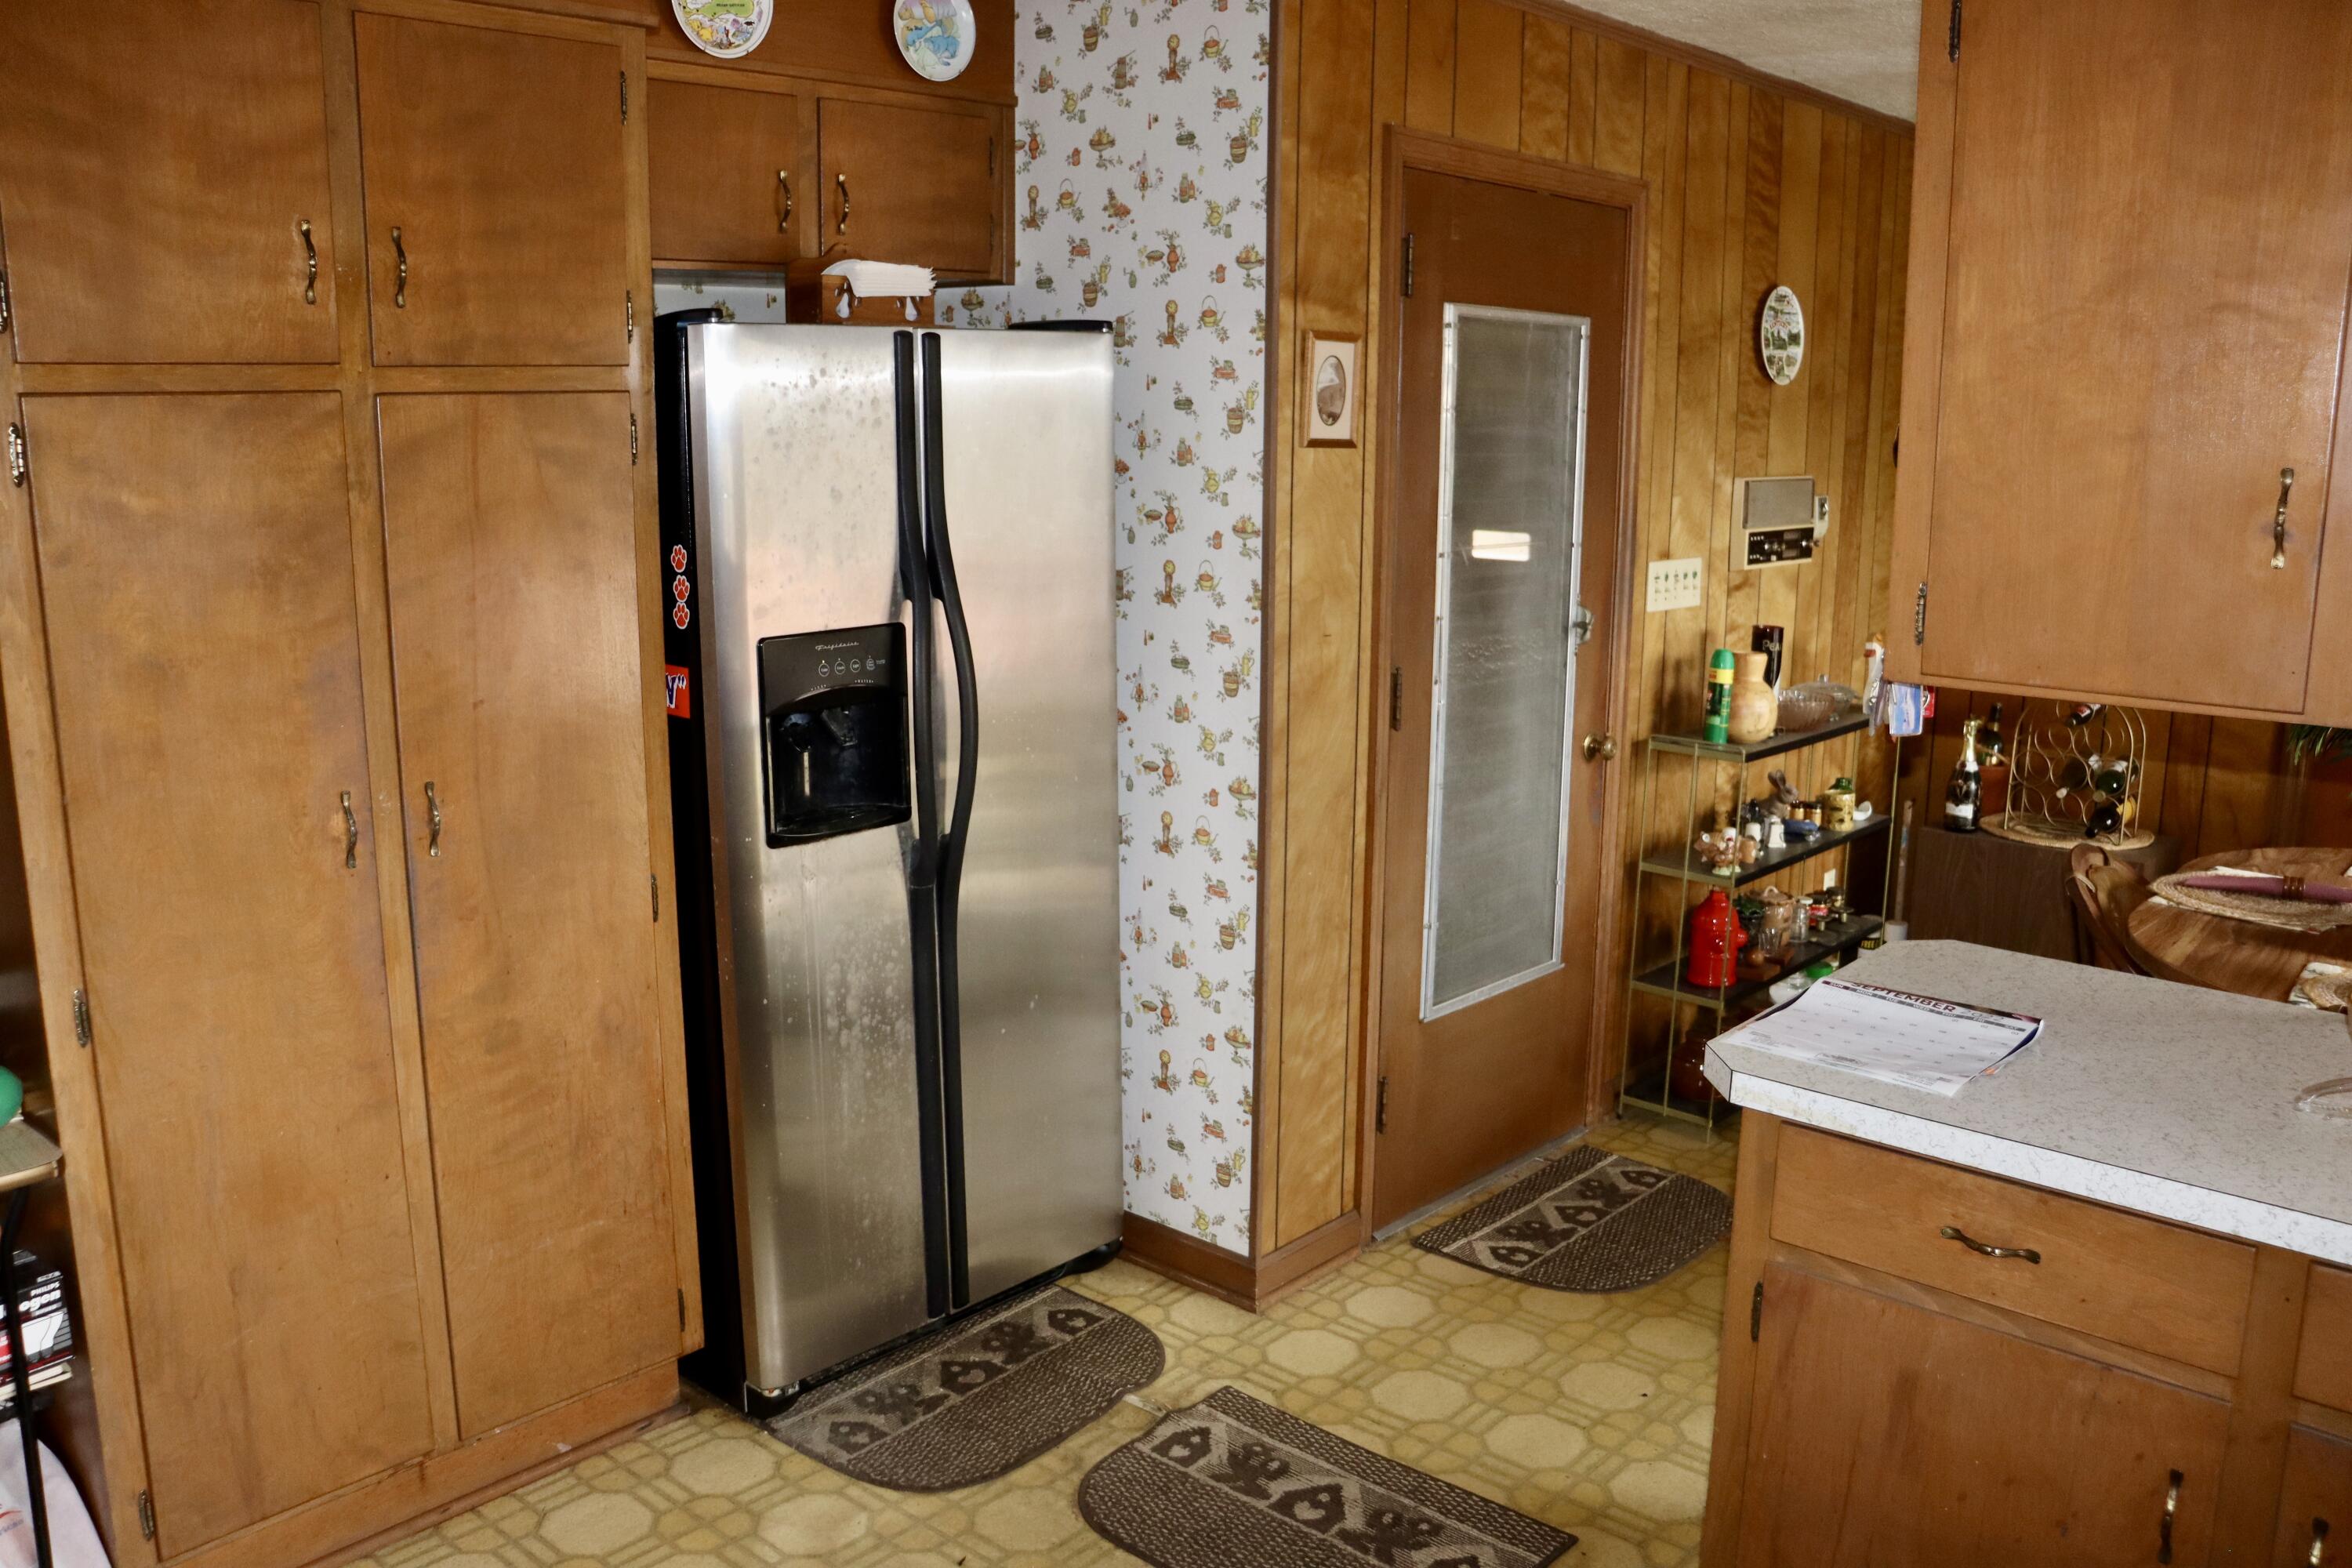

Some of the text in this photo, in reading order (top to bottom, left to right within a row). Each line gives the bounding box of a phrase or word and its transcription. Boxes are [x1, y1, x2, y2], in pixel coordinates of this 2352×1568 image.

[815, 642, 859, 651] Frigidaire
[1850, 982, 1957, 1012] SEPTEMBER
[31, 1281, 60, 1296] PHILIPS
[19, 1289, 61, 1312] ogen
